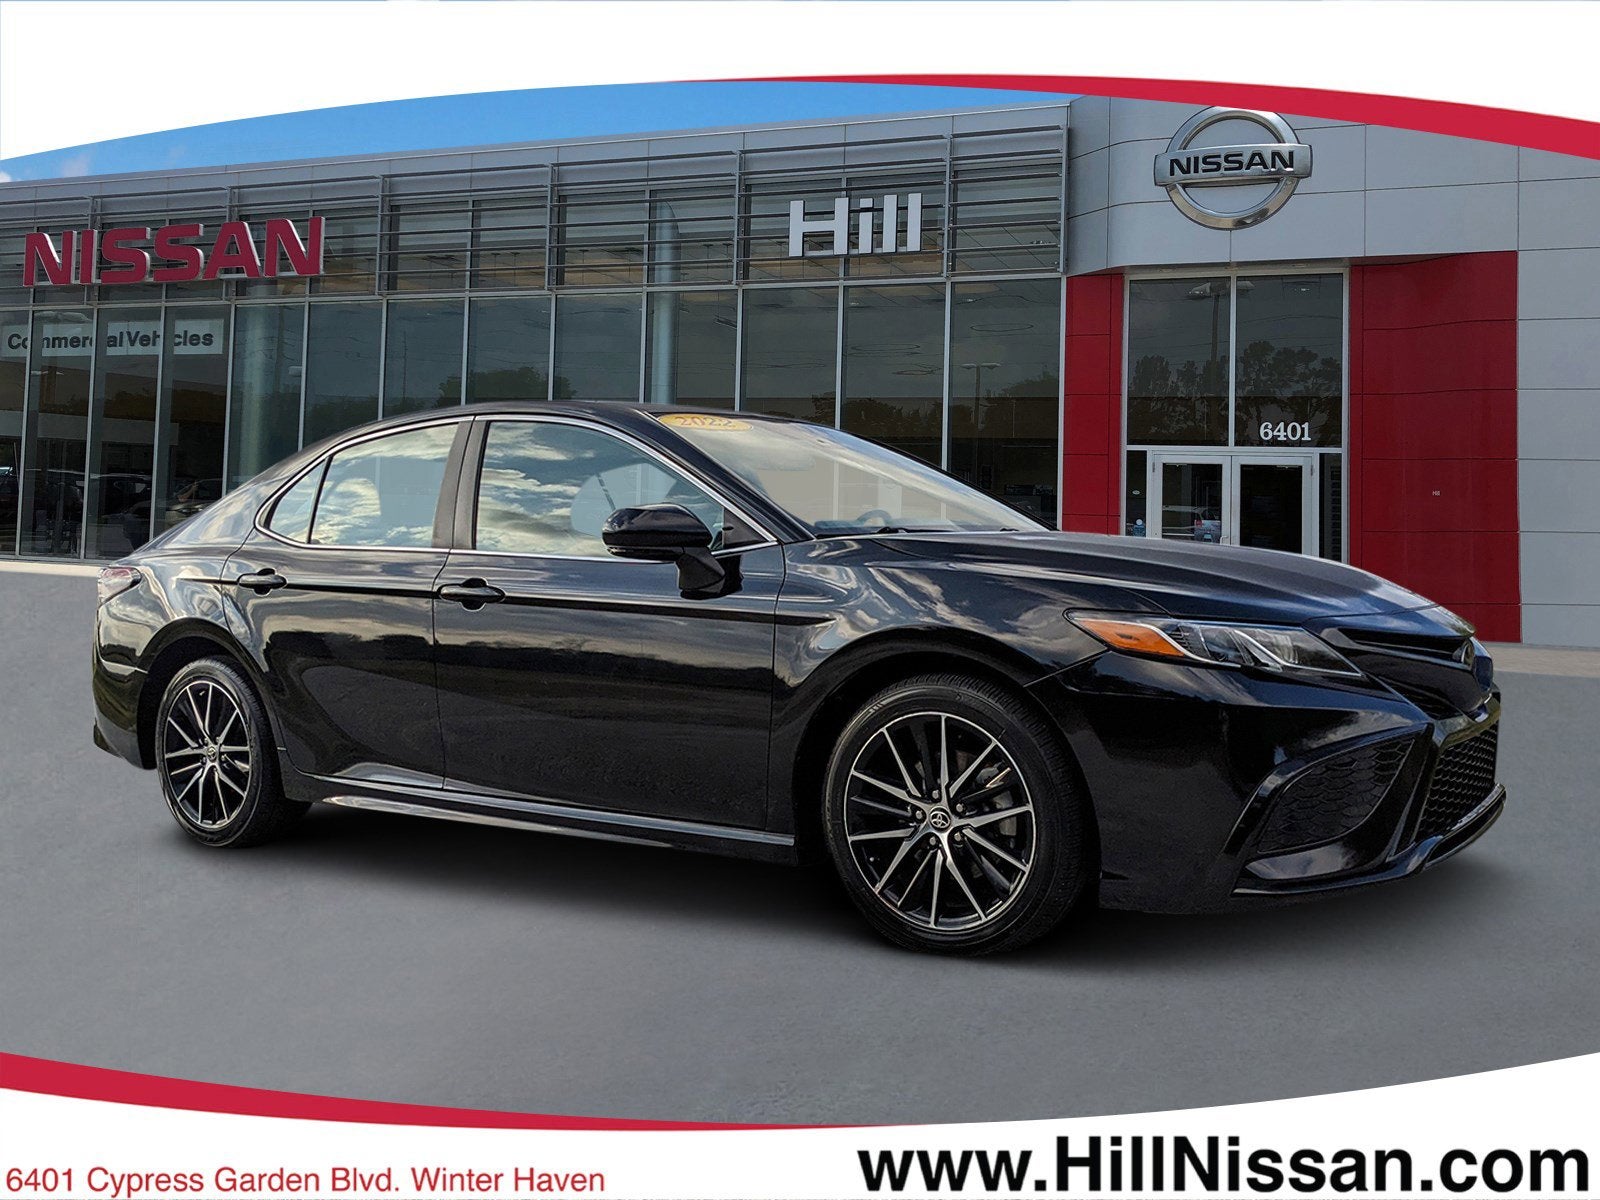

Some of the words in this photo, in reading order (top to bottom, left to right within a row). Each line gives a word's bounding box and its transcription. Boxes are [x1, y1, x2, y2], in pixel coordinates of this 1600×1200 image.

[1169, 150, 1295, 177] NISSAN
[788, 192, 922, 257] Hill
[23, 216, 326, 287] NISSAN
[126, 330, 214, 347] Vehcles
[674, 416, 737, 428] 2022
[1259, 421, 1312, 441] 6401
